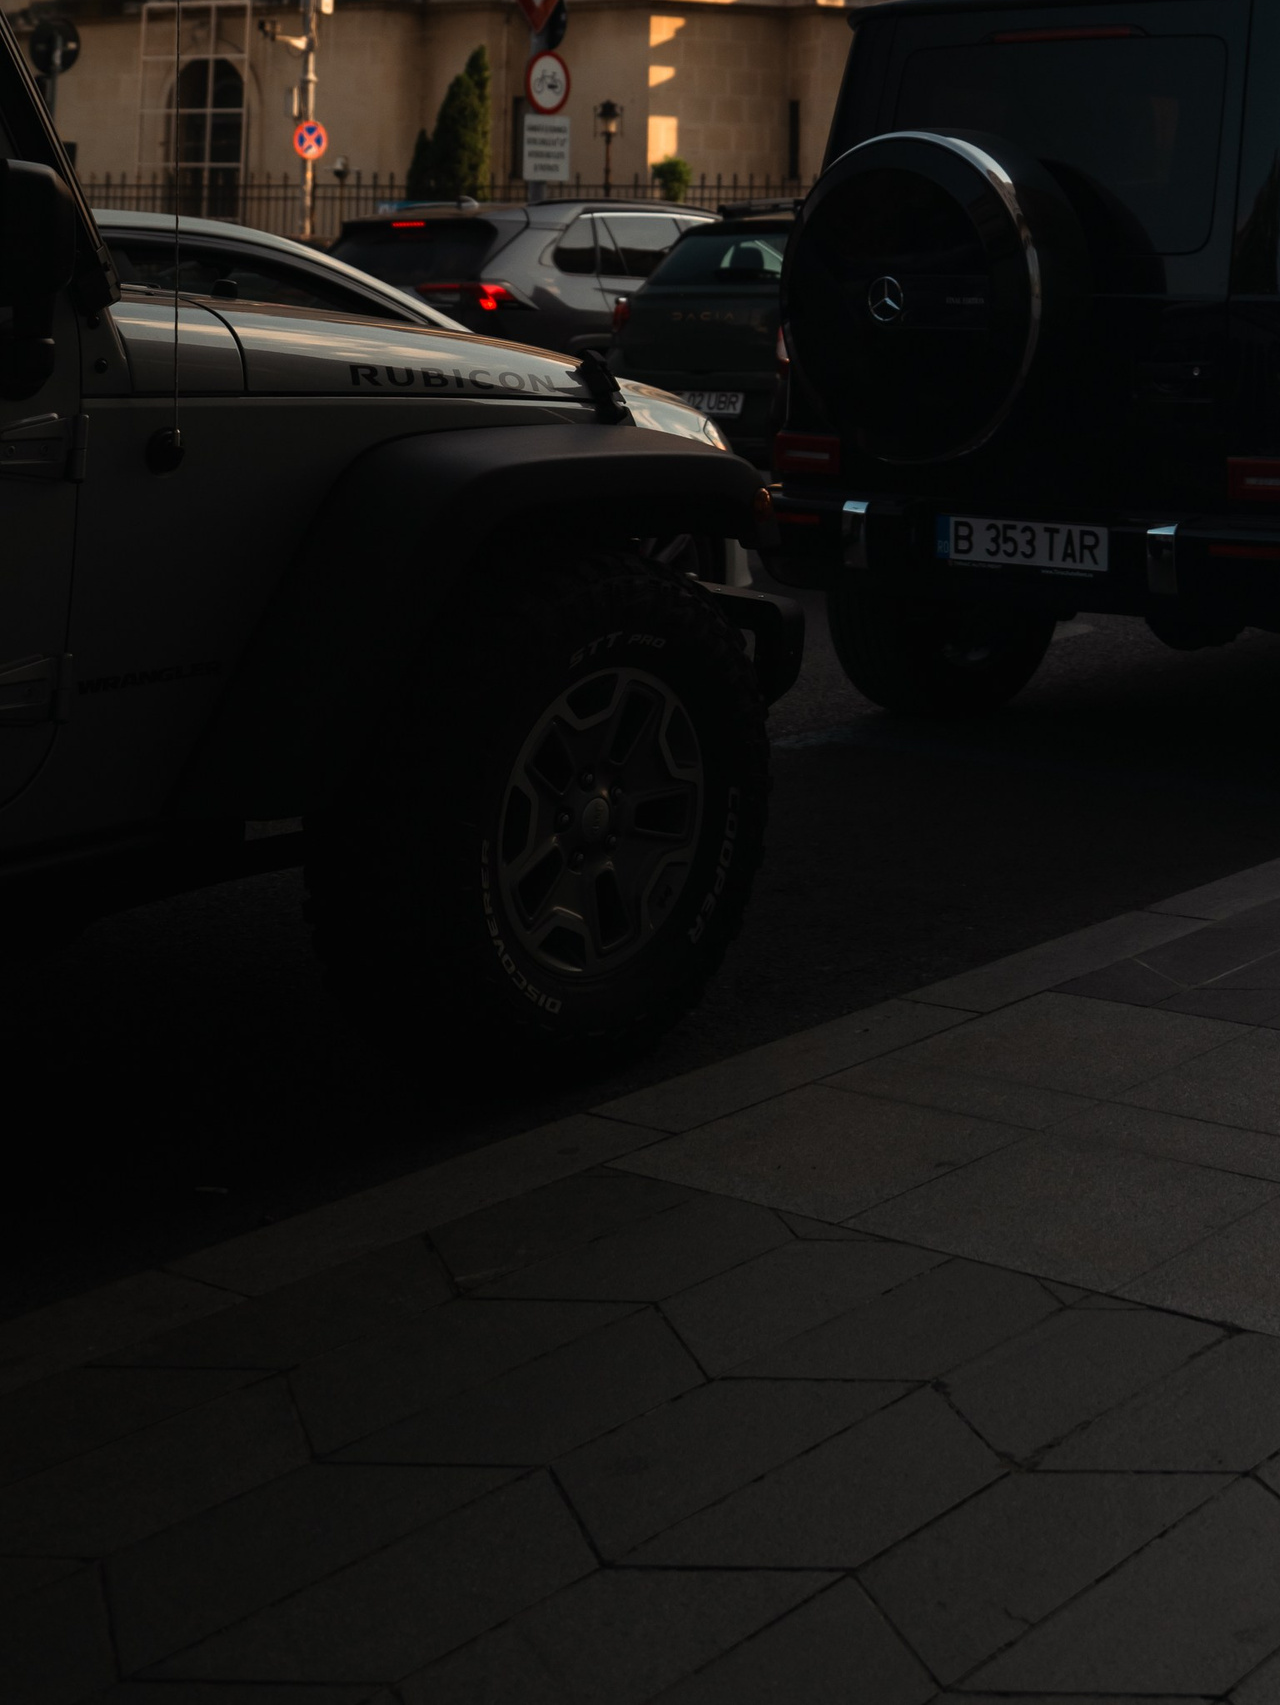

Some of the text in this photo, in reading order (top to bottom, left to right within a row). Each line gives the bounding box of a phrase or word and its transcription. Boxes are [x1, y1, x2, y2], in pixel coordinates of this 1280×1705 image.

[670, 311, 735, 322] DACIA
[349, 364, 557, 393] RUBICON
[706, 393, 739, 411] UBR
[937, 520, 1099, 566] RO B 353 TAR
[568, 630, 666, 670] STT PRO
[77, 660, 222, 695] WRANGLER
[687, 785, 741, 945] COOPER
[480, 838, 562, 1014] DISCOVERER
